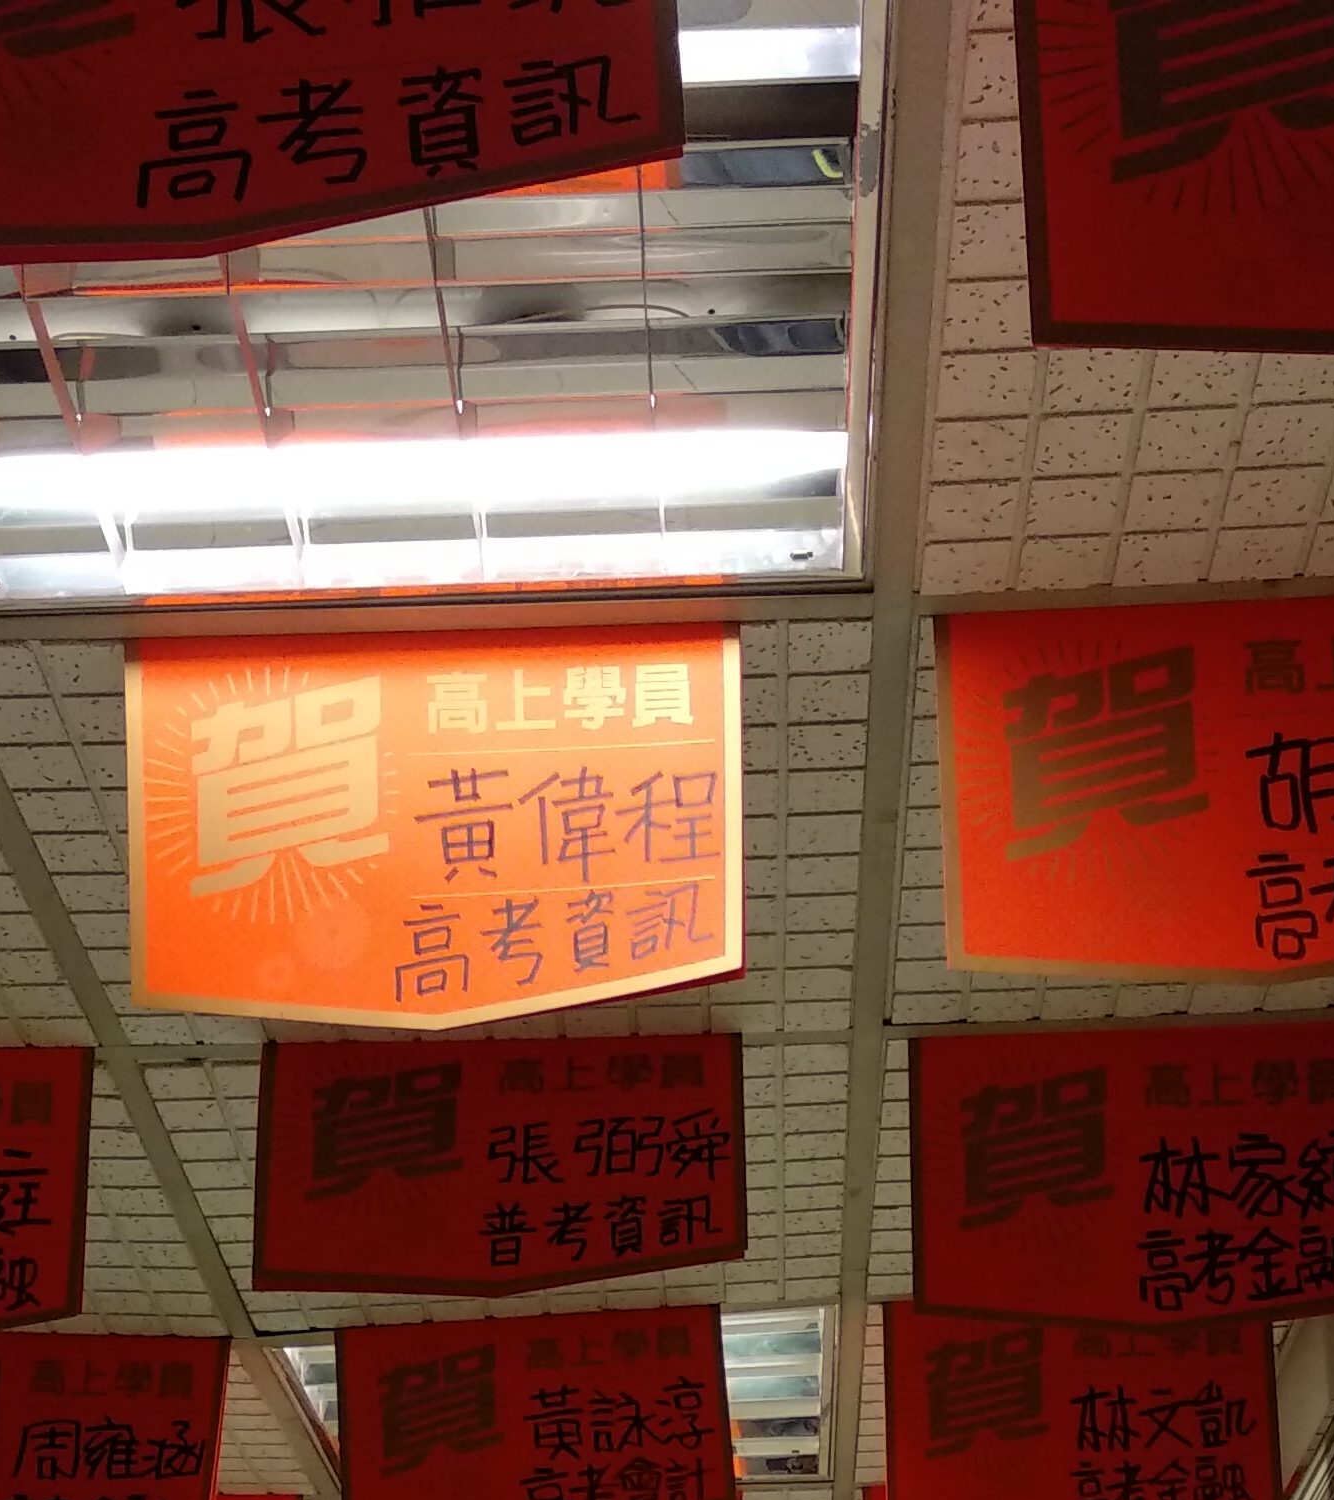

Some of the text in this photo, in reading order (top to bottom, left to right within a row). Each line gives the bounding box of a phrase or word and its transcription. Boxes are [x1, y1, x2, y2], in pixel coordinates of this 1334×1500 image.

[135, 55, 639, 210] 高考資訊
[426, 663, 694, 734] 高上學員
[1004, 645, 1209, 861] 賀
[190, 675, 389, 898] 賀
[414, 766, 720, 883] 黃偉程
[393, 883, 713, 1004] 高考資訊
[959, 1066, 1116, 1231] 賀
[479, 1194, 723, 1267] 普考資訊
